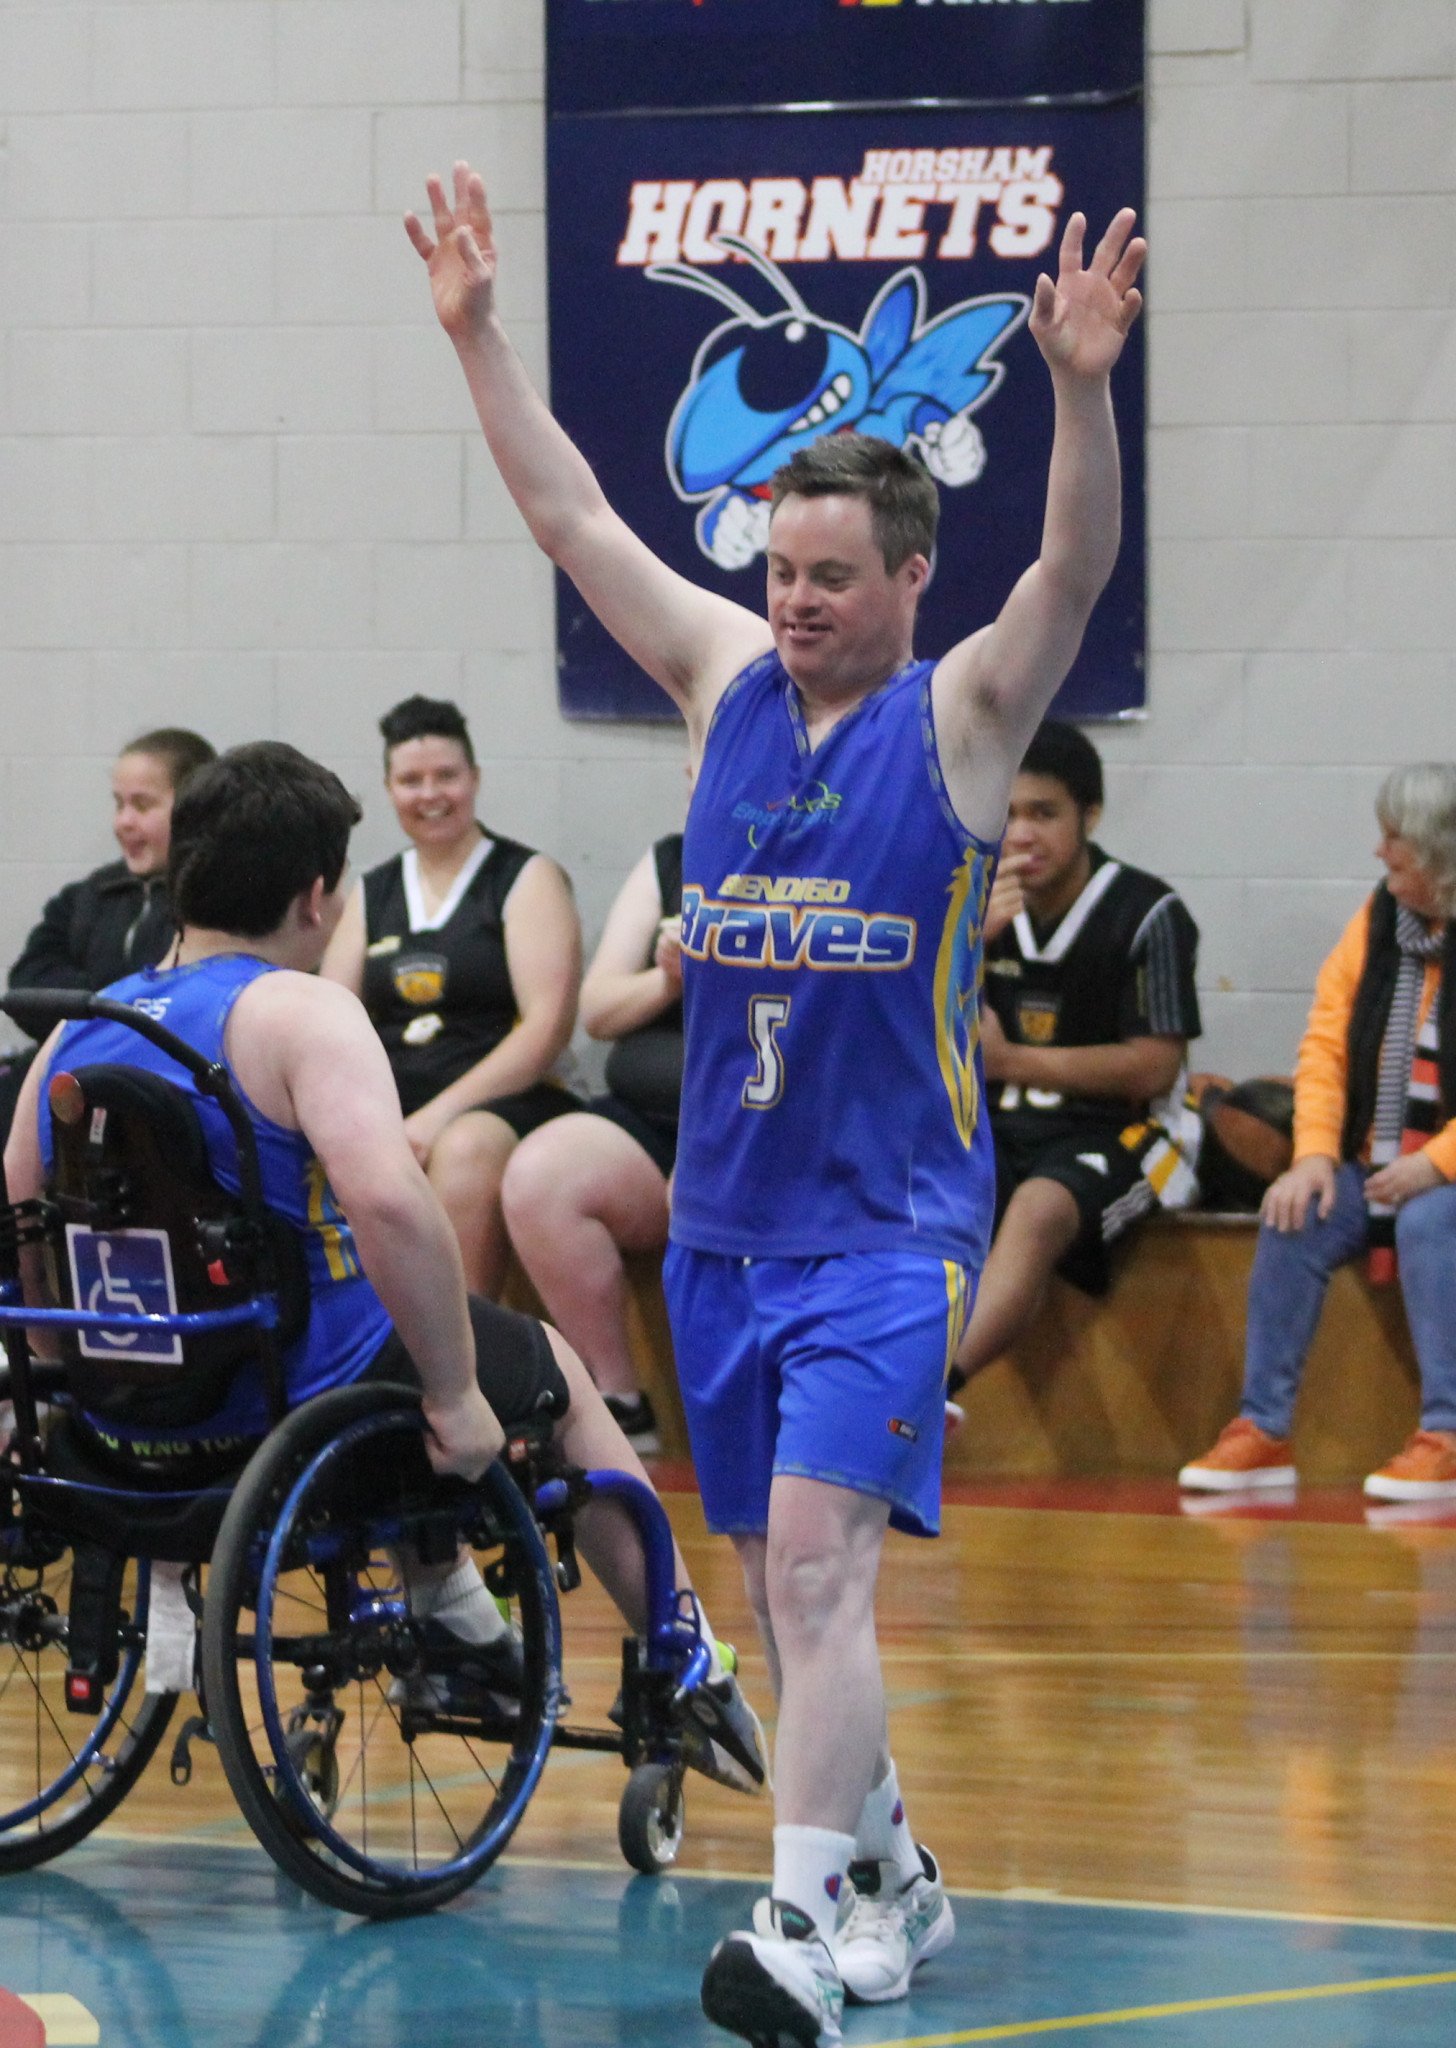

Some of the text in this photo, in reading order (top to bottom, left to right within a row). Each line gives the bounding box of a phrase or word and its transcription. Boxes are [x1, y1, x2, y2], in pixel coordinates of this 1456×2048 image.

[861, 145, 1054, 183] HORSHAM
[617, 175, 1063, 265] HORNETS
[718, 873, 850, 903] BENDIGO
[681, 884, 917, 971] Braves
